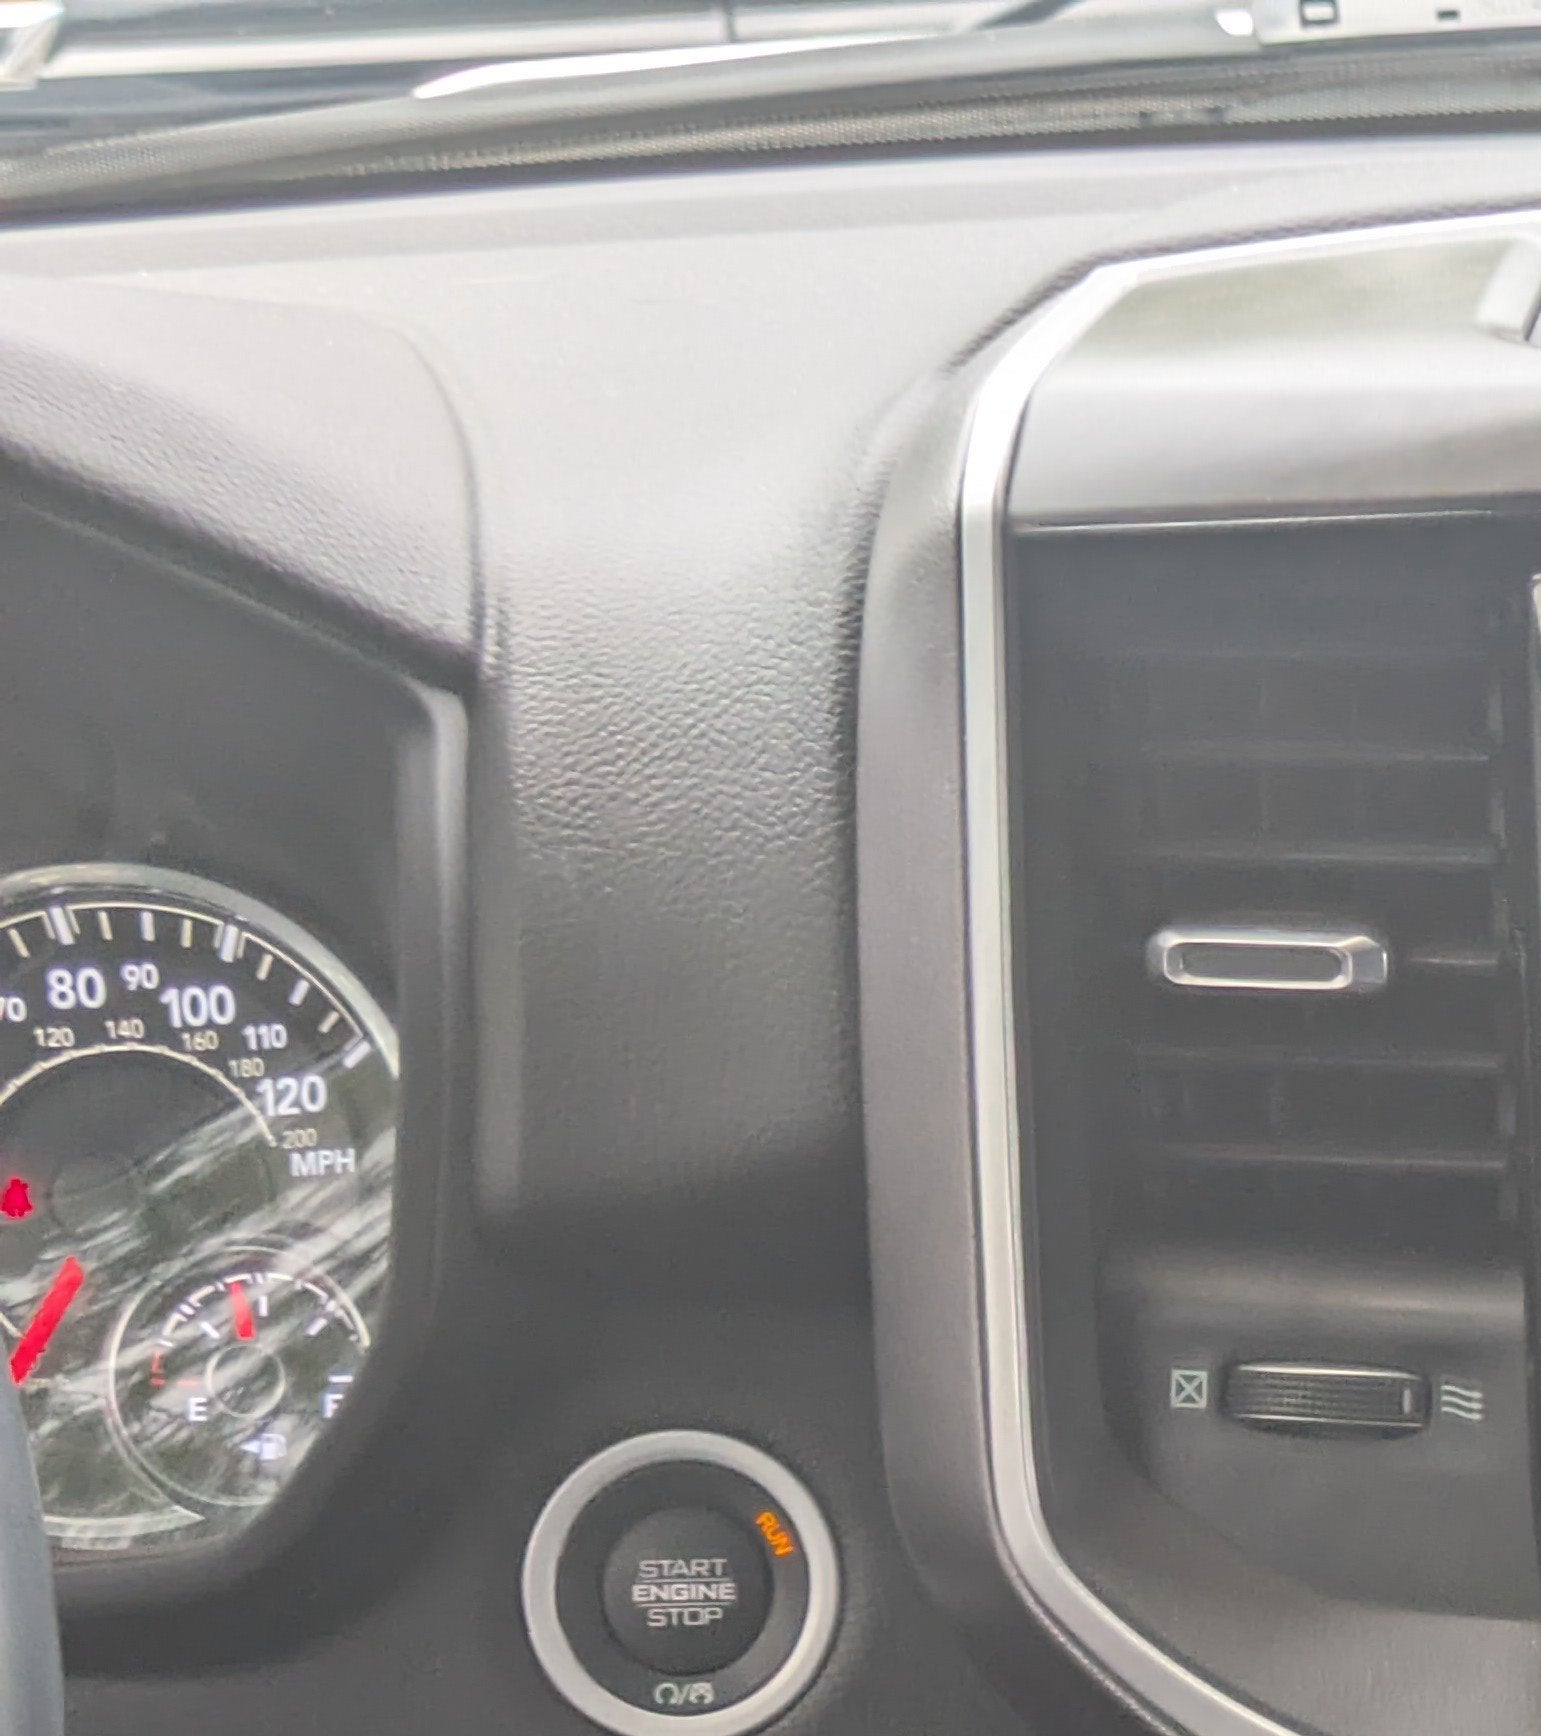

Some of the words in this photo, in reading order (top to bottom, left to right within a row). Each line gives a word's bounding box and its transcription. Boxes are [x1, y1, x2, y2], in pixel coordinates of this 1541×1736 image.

[48, 967, 106, 1009] 80
[121, 963, 159, 990] 90
[0, 996, 28, 1023] 0
[160, 984, 238, 1029] 100
[33, 1026, 75, 1048] 120
[105, 1018, 145, 1040] 140
[180, 1030, 219, 1051] 160
[242, 1022, 289, 1051] 110
[228, 1057, 265, 1079] 180
[255, 1075, 328, 1117] 120
[282, 1128, 318, 1149] 200
[290, 1148, 357, 1178] MPH
[187, 1397, 208, 1422] E
[756, 1511, 793, 1556] RUN
[638, 1558, 728, 1579] START
[630, 1582, 737, 1602] ENGINE
[647, 1607, 723, 1627] STOP
